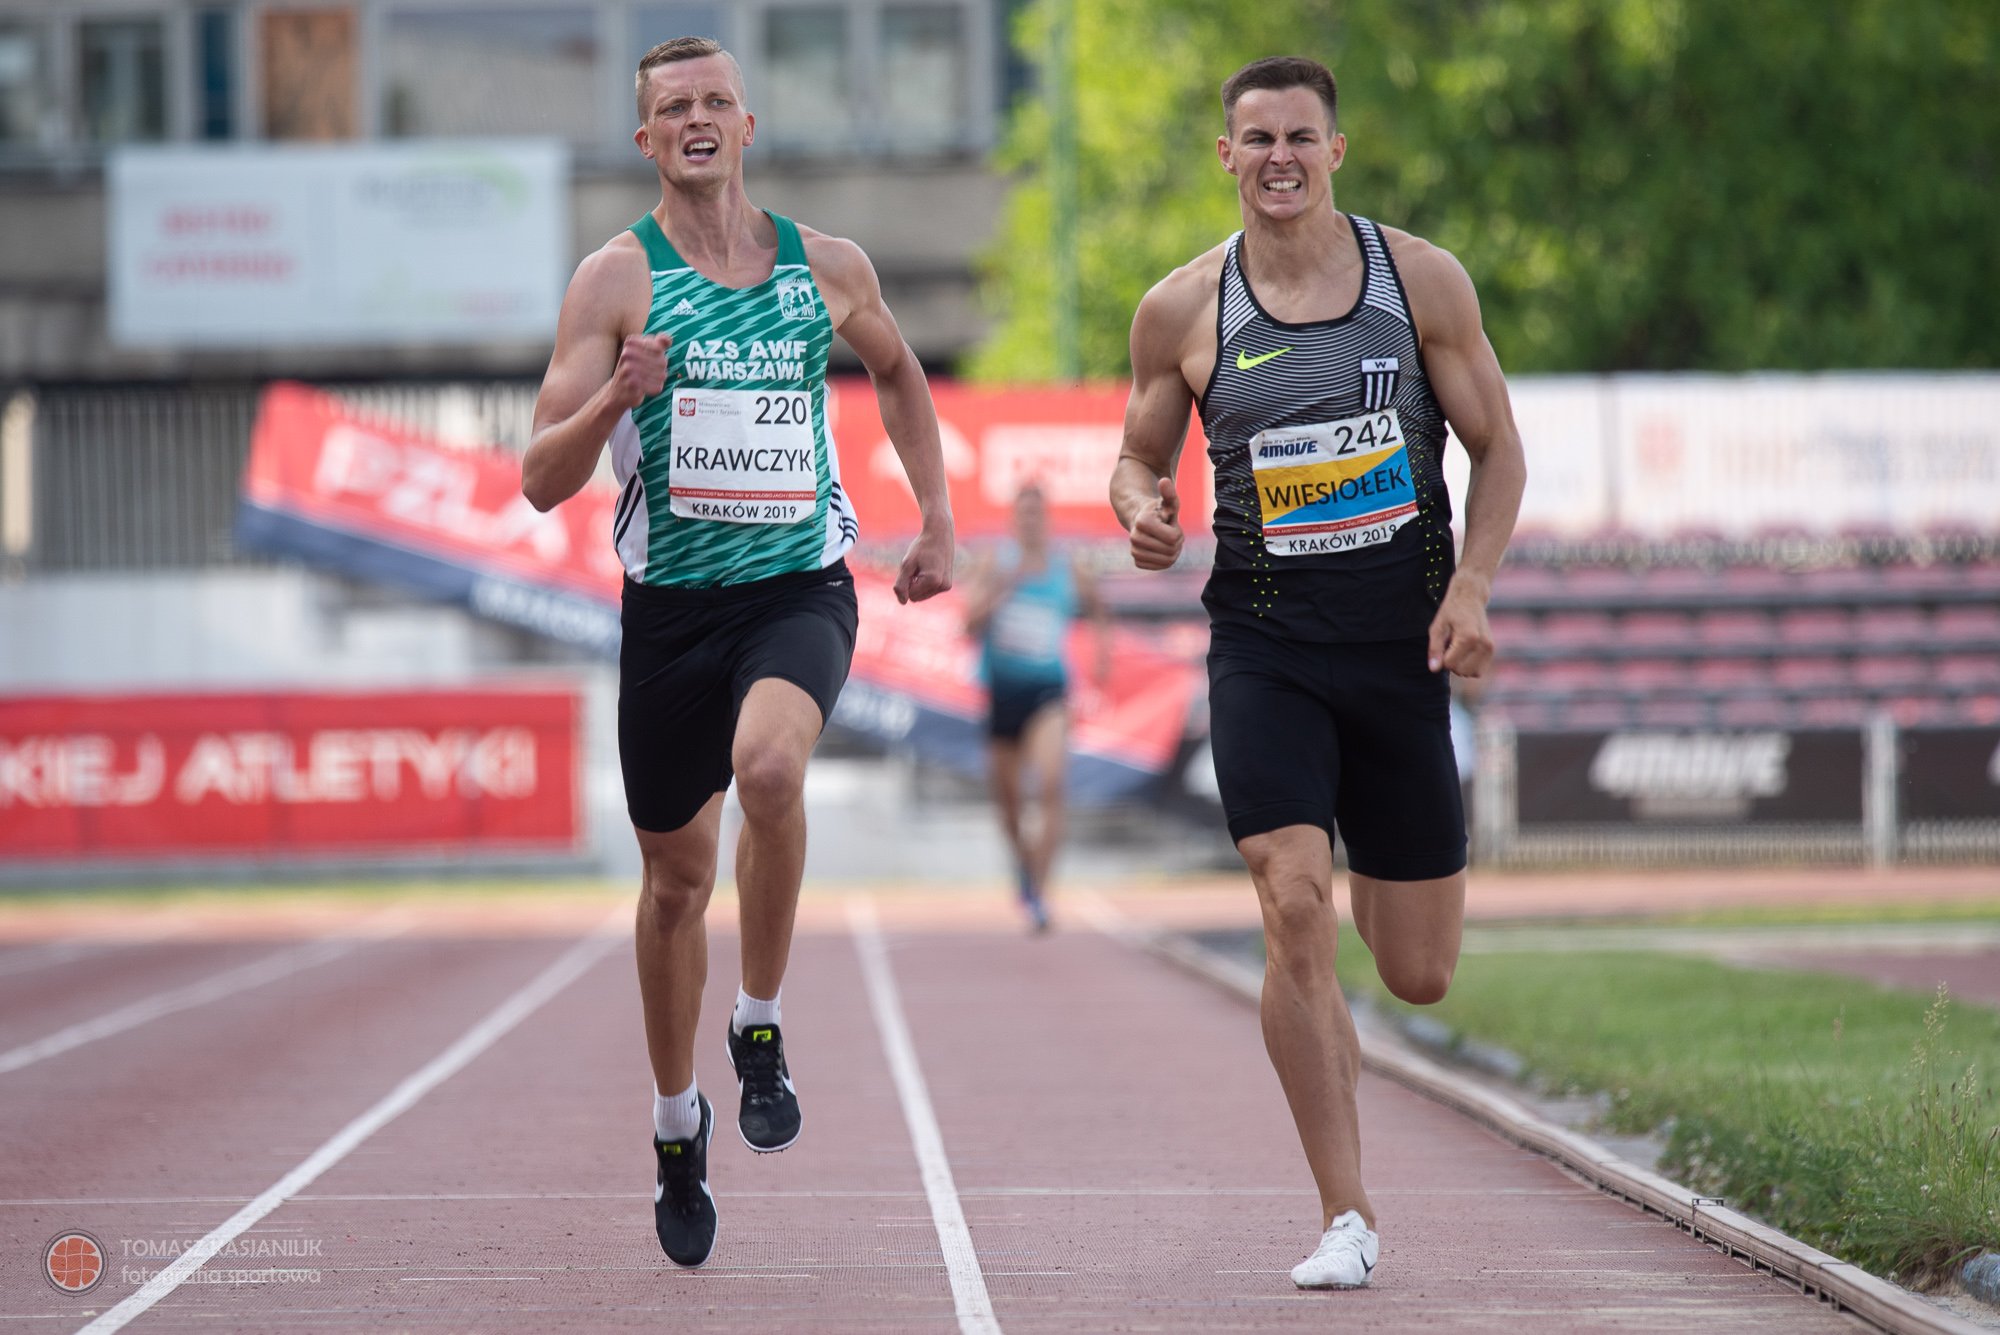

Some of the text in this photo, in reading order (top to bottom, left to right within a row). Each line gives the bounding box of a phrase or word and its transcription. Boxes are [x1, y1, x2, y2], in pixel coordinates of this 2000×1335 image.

[685, 340, 808, 360] AZS AWF
[685, 361, 804, 380] WARSZAWA
[1374, 361, 1387, 369] W
[755, 396, 807, 425] 220
[1334, 414, 1397, 455] 242
[676, 446, 812, 472] KRAWCZYK
[1264, 464, 1408, 508] WIESIOŁEK
[692, 502, 796, 518] KRAKÓW 2019
[1289, 524, 1397, 552] KRAKÓW 2019
[174, 725, 538, 806] ATLETYKI
